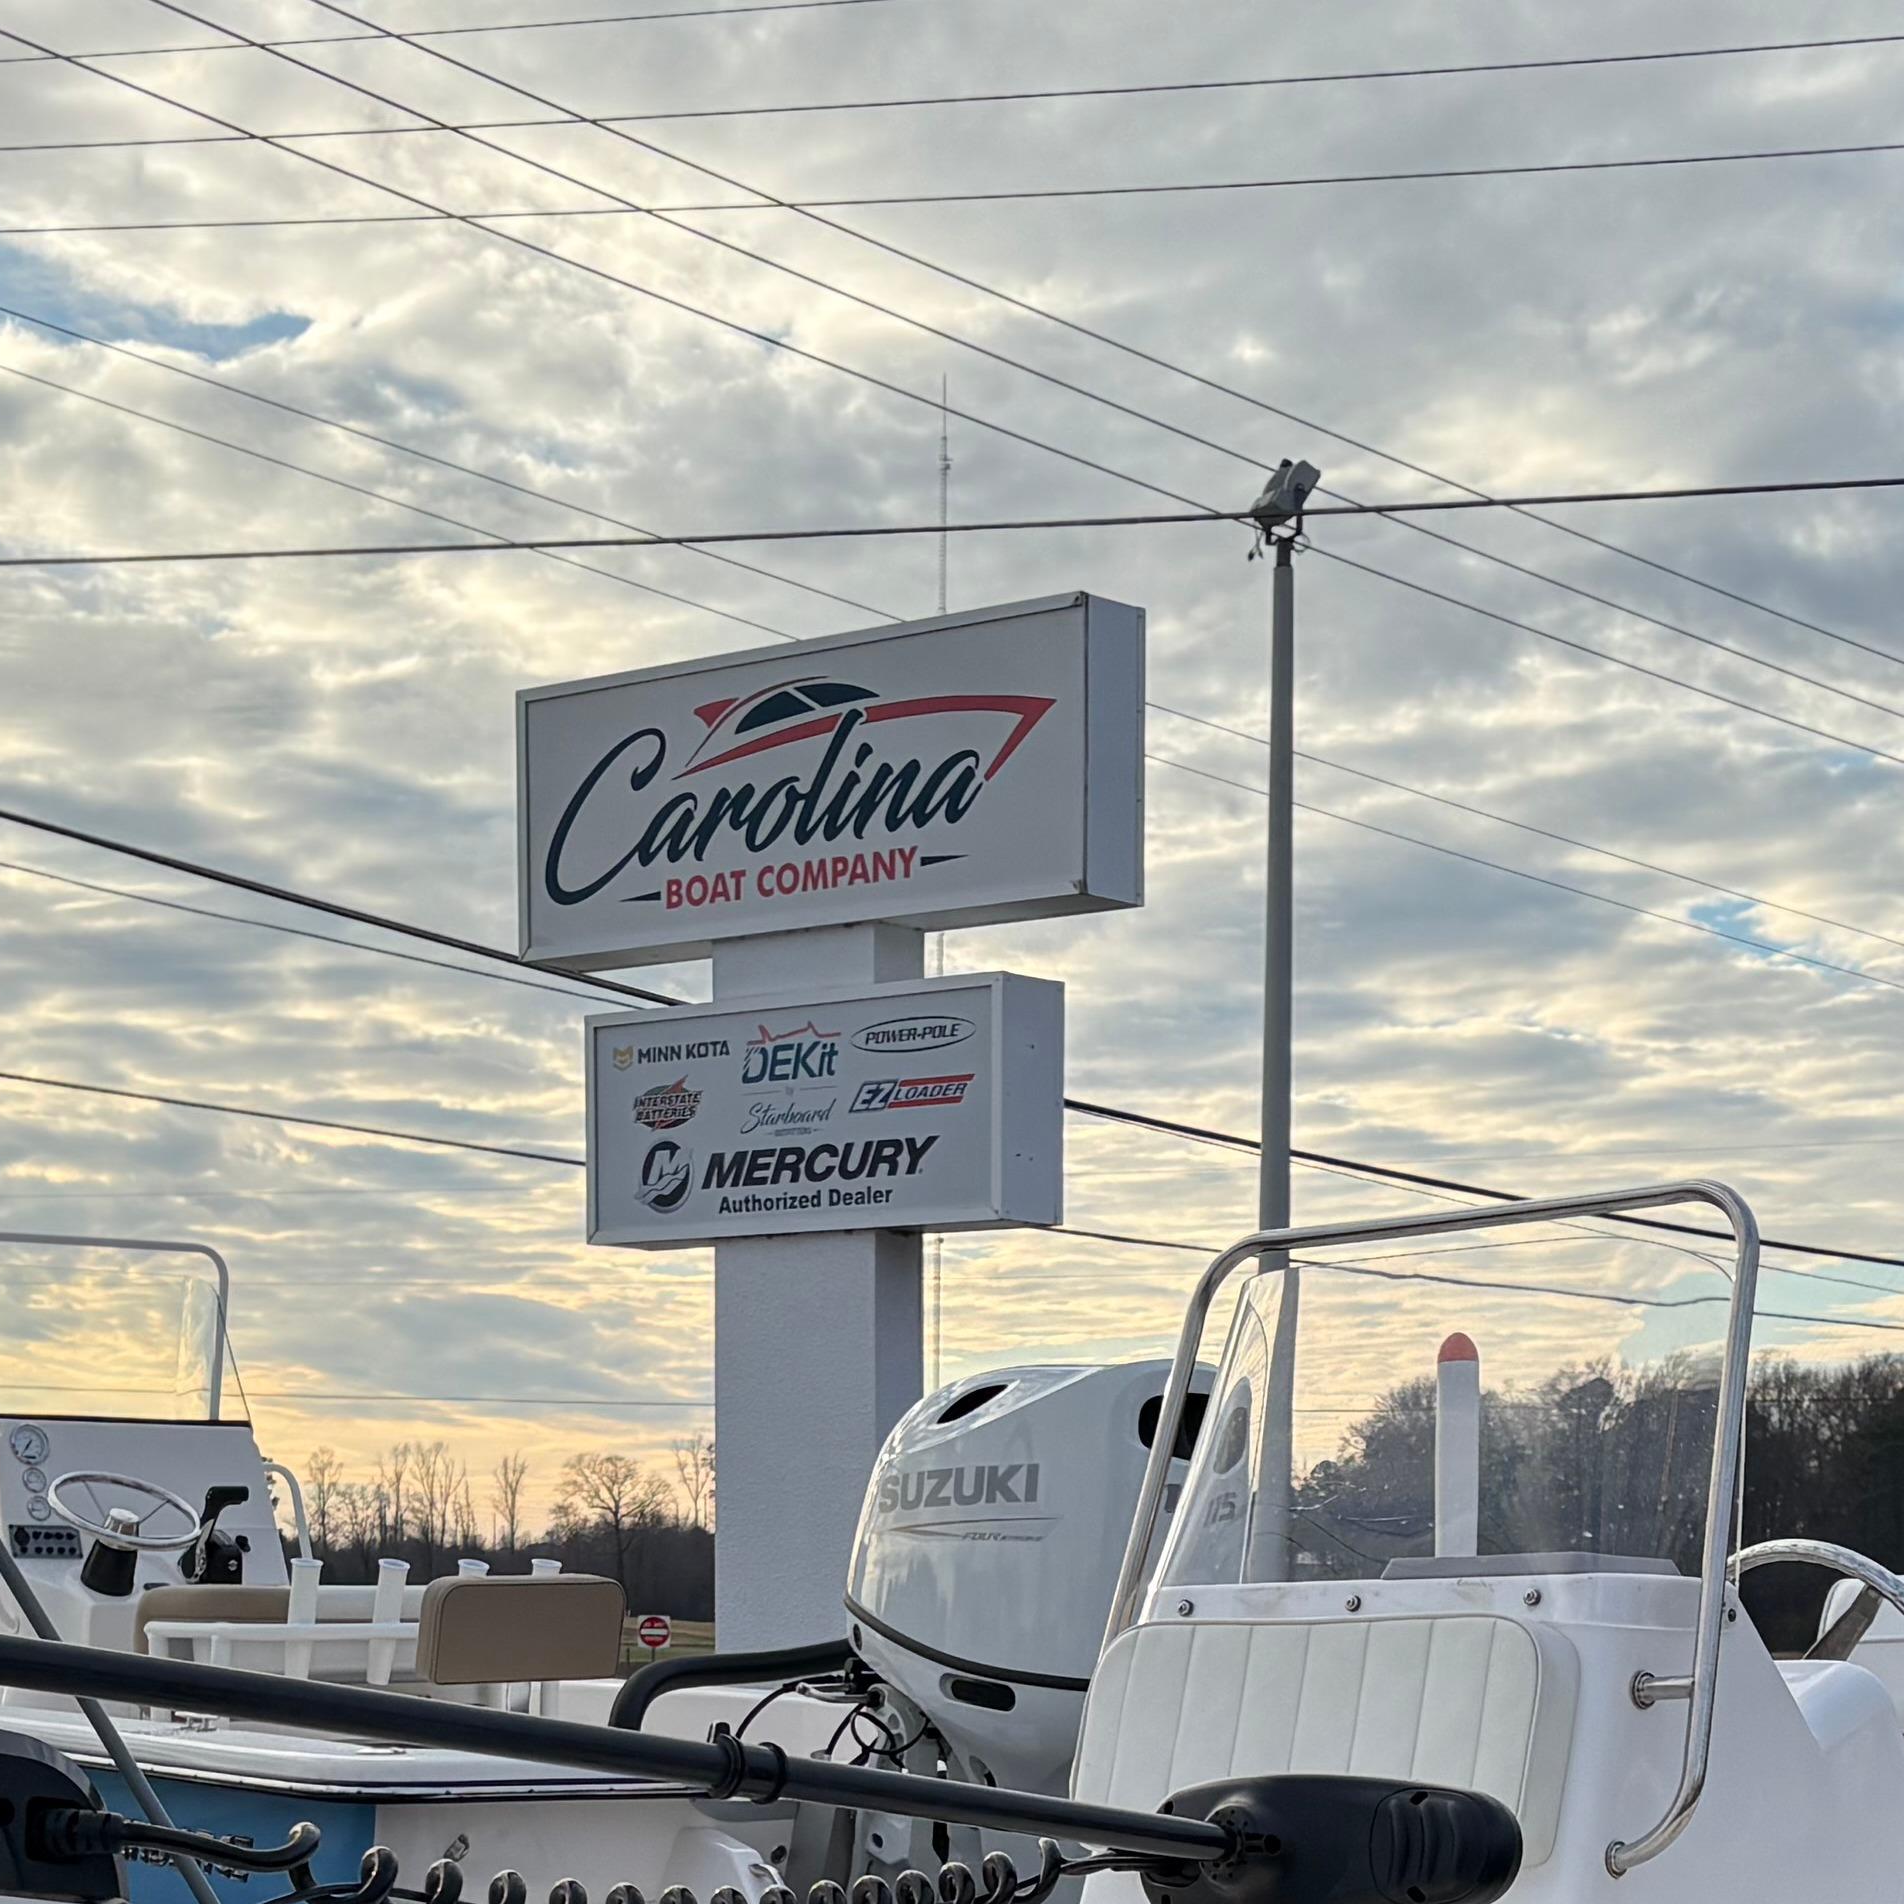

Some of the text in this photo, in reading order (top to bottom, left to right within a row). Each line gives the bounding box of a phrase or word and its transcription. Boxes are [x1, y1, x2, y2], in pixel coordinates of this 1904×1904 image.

[545, 708, 986, 905] Carolina
[665, 846, 918, 909] BOAT COMPANY
[865, 1023, 961, 1045] POWER-POLE
[637, 1040, 730, 1065] MINN KOTA
[634, 1090, 702, 1108] INTERSTATE
[857, 1081, 969, 1110] EZ LOADER
[635, 1106, 698, 1122] BATTERIES
[701, 1135, 940, 1190] MERCURY
[718, 1186, 893, 1214] Authorized Dealer
[878, 1463, 1040, 1514] SUZUKI
